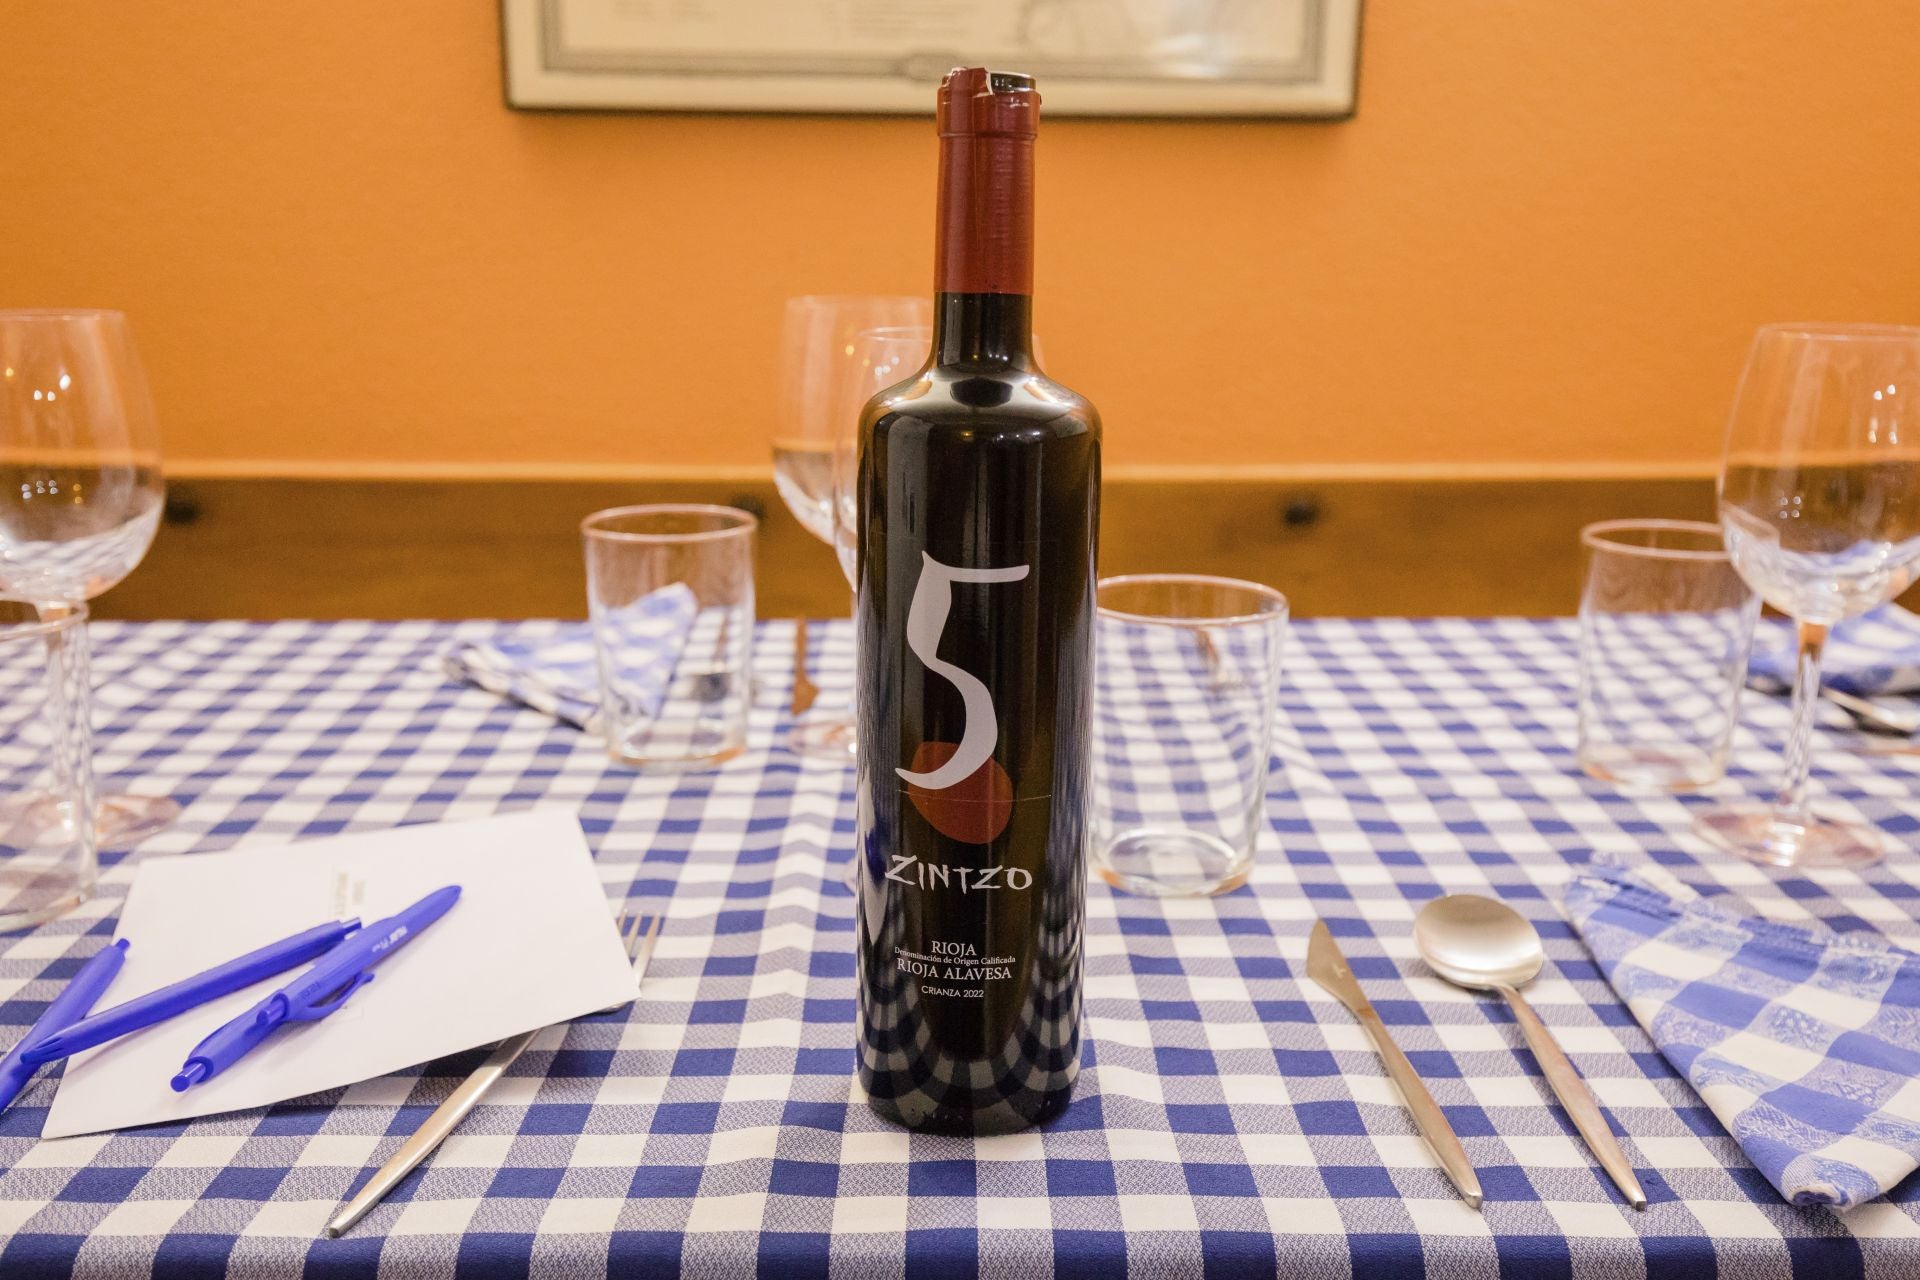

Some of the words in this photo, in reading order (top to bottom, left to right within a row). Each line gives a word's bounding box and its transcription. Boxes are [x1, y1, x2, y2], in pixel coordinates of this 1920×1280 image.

[884, 854, 1033, 894] ZINTZO
[894, 946, 942, 963] Denominación
[943, 956, 953, 964] de
[953, 956, 979, 967] Origen
[981, 955, 1016, 965] Calificada
[931, 940, 977, 958] RIOJA
[897, 958, 939, 978] RIOJA
[943, 966, 1012, 981] ALAVESA
[921, 985, 961, 998] CRIANZA
[963, 988, 985, 998] 2022
